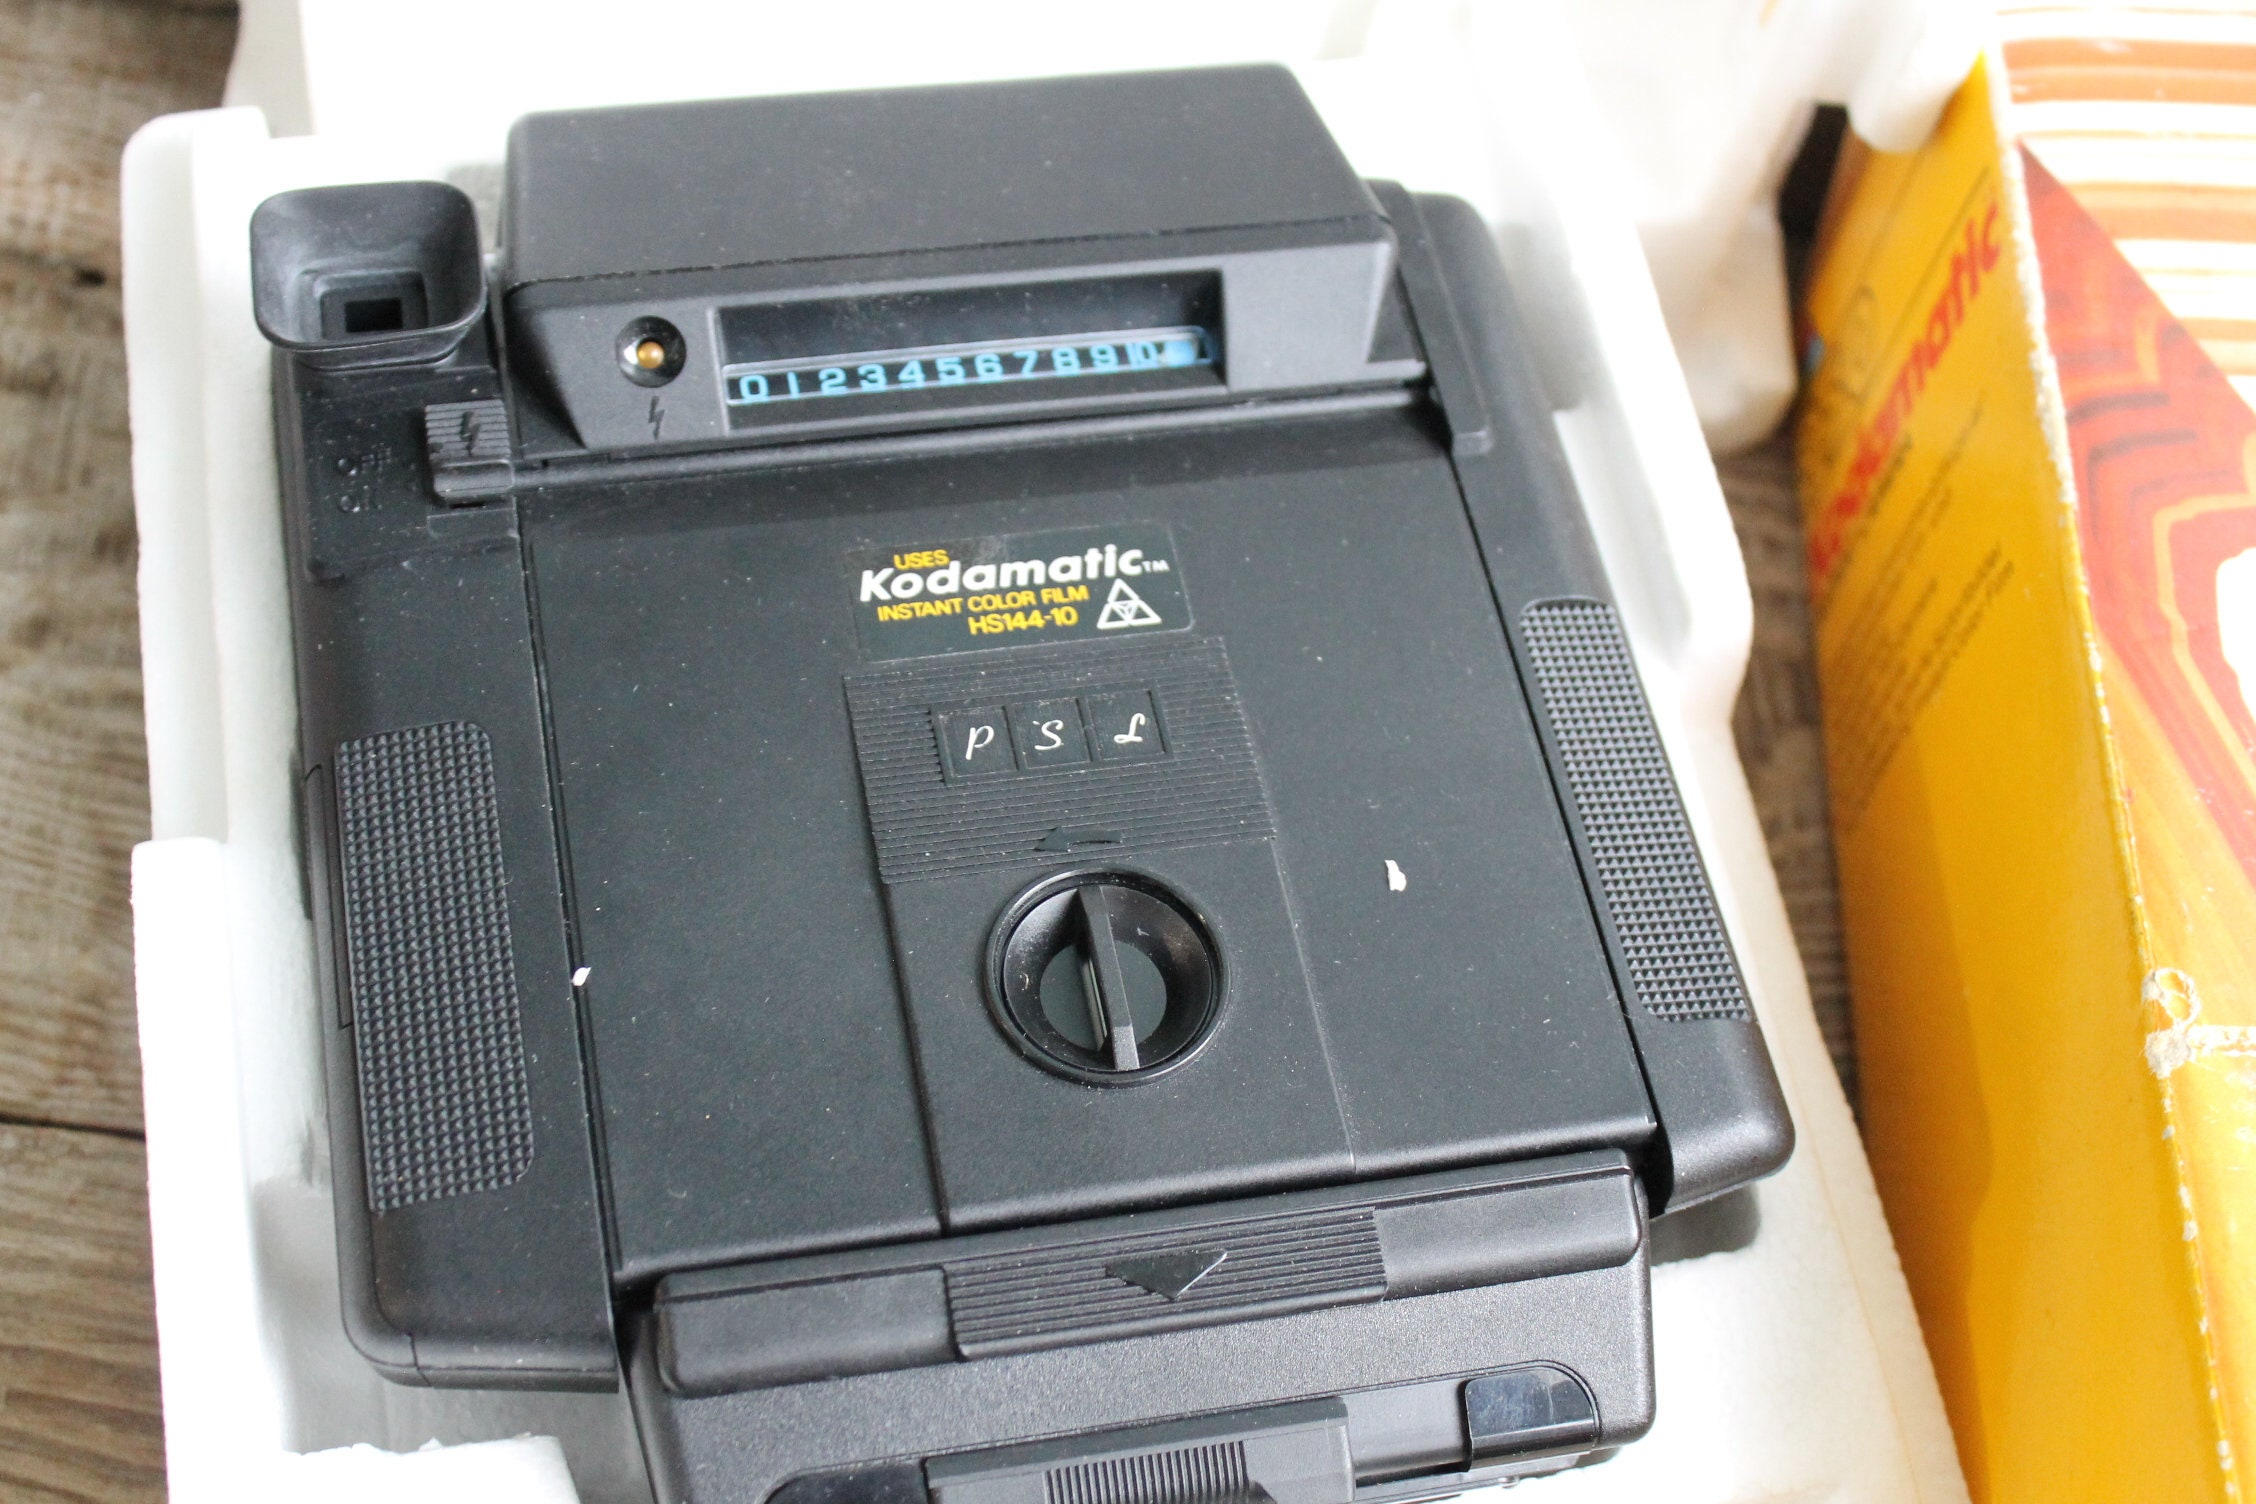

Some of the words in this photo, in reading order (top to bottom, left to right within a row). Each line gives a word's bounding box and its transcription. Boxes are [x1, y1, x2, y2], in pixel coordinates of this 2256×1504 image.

[739, 375, 769, 403] 0
[787, 371, 800, 399] 1
[818, 367, 849, 396] 2
[857, 363, 887, 392] 3
[898, 359, 926, 388] 4
[935, 356, 966, 385] 5
[974, 353, 1004, 382] 6
[1012, 350, 1039, 378] 7
[1051, 347, 1080, 376] 8
[1089, 344, 1119, 373] 9
[1125, 341, 1159, 370] 10
[860, 544, 1144, 602] Kodamatic
[1142, 560, 1169, 573] TM
[893, 549, 950, 570] USES
[877, 597, 963, 622] INSTANT
[967, 590, 1036, 613] COLOR
[1040, 585, 1090, 605] FILM
[967, 606, 1079, 635] HS144-10
[965, 725, 995, 761] P
[1034, 719, 1065, 751] S
[1113, 712, 1146, 744] L
